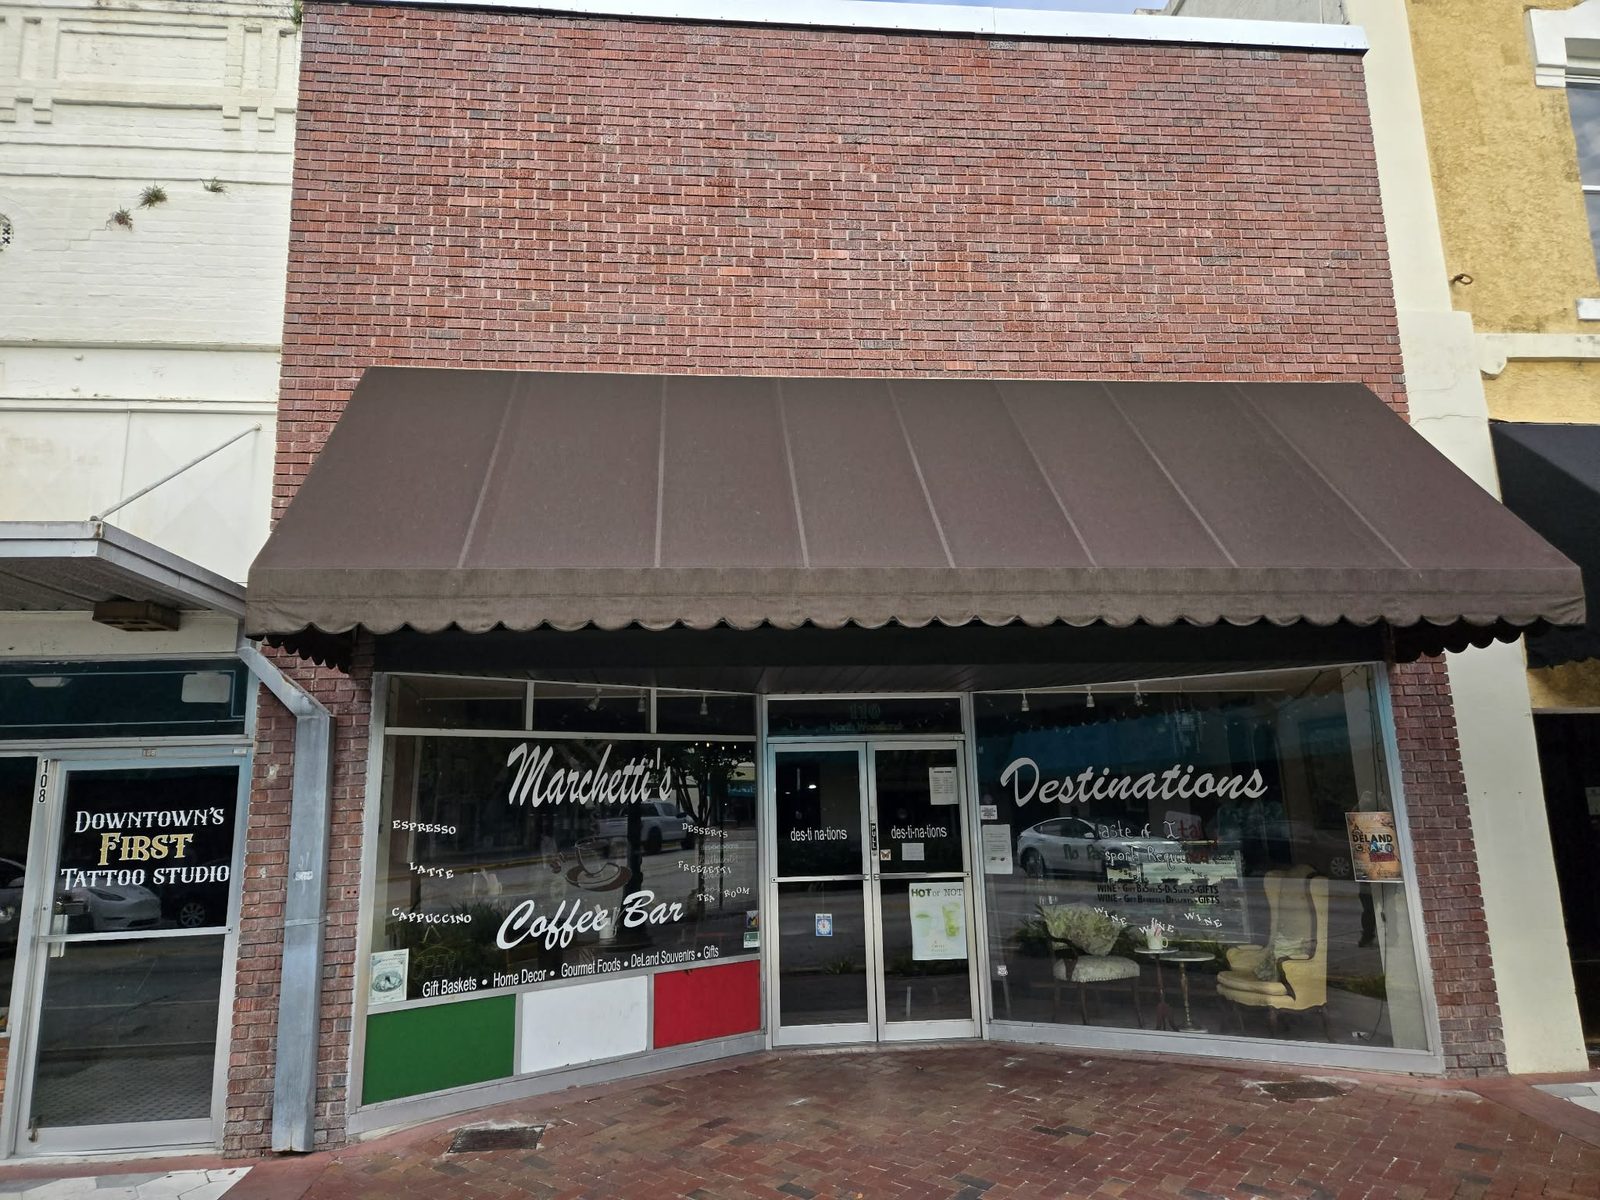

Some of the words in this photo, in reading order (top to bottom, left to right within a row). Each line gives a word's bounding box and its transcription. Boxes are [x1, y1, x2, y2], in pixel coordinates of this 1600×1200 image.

[39, 759, 49, 803] 108
[507, 743, 673, 808] Marchetti's
[1000, 757, 1268, 807] Destinations
[75, 807, 224, 832] DOWNTOWN'S
[393, 820, 456, 835] ESPRESSO
[682, 822, 728, 838] DESSERTS
[1353, 834, 1392, 843] DELAND
[97, 832, 193, 866] FIRST
[409, 862, 454, 880] LATTE
[678, 861, 731, 874] FREEZETTI
[61, 868, 145, 891] TATTOO
[153, 865, 230, 885] STUDIO
[697, 893, 715, 903] TEA
[724, 886, 750, 898] ROOM
[911, 888, 931, 898] HOT
[944, 888, 963, 897] NOT
[1197, 885, 1219, 894] GIFTS
[392, 907, 472, 924] CAPPUCCINO
[496, 899, 609, 950] Coffee
[622, 889, 684, 928] Bar
[1094, 906, 1127, 927] WINE
[1184, 912, 1223, 928] WINE
[422, 981, 439, 998] Gift
[441, 976, 477, 995] Baskets
[493, 972, 519, 988] Home
[521, 968, 547, 984] Decor
[561, 959, 596, 978] Gourmet
[598, 957, 621, 973] Foods
[631, 951, 660, 968] DeLand
[661, 948, 696, 964] Souvenirs
[703, 944, 719, 960] Gifts
